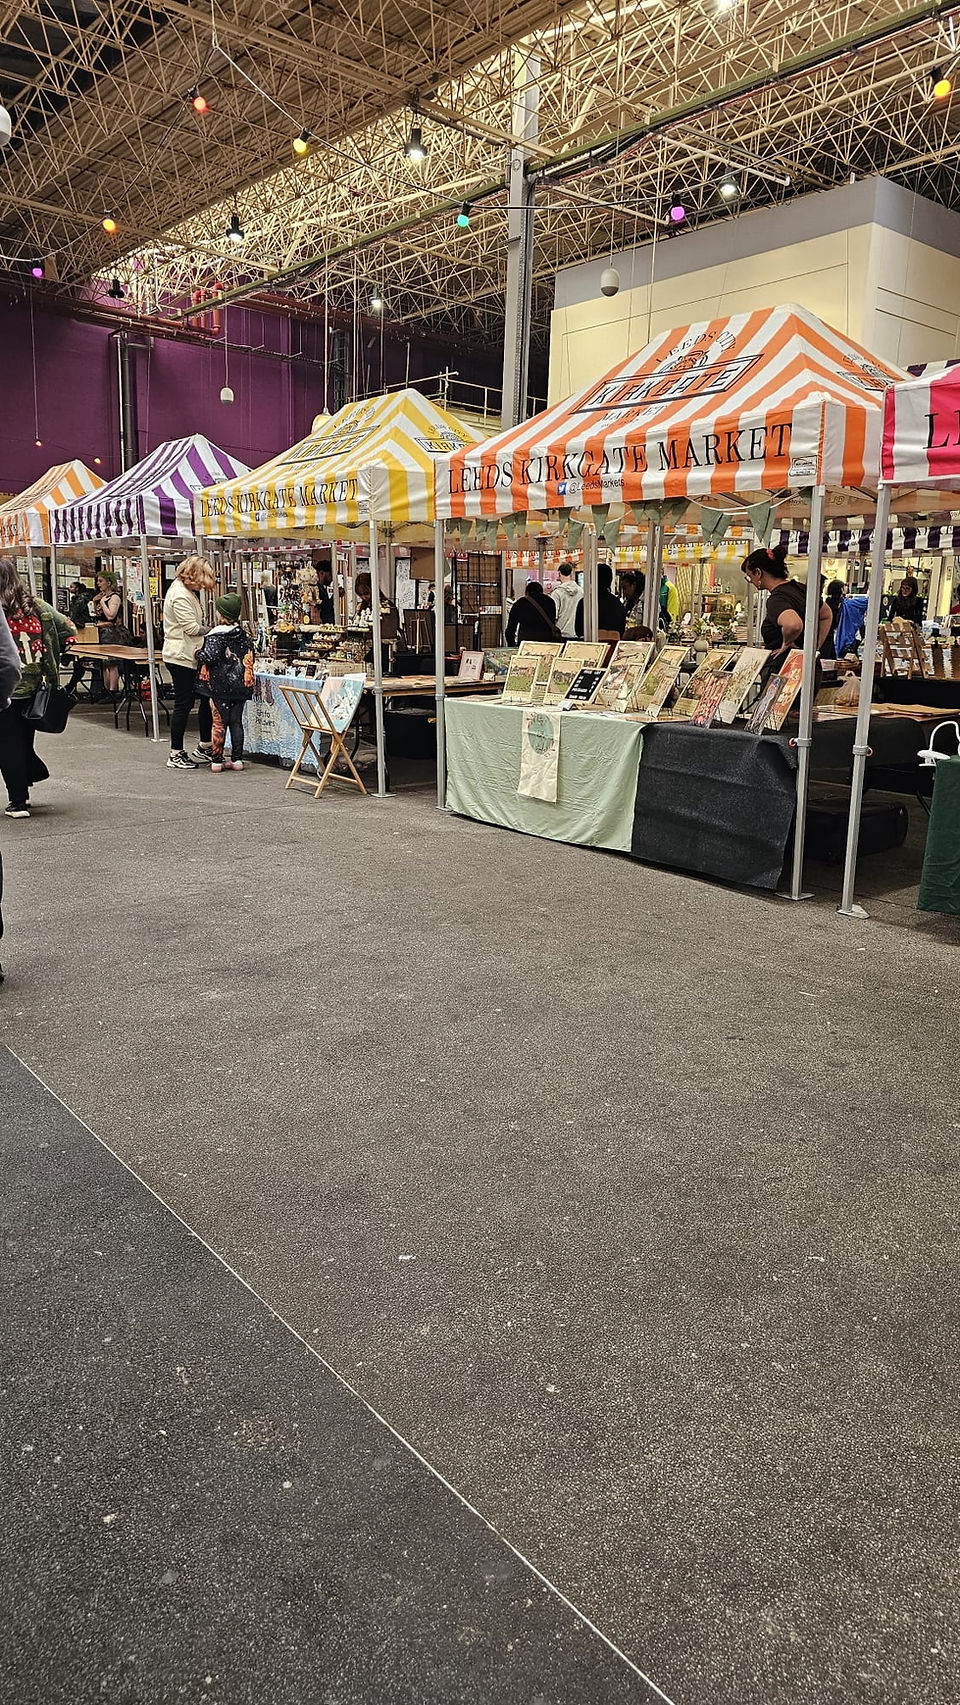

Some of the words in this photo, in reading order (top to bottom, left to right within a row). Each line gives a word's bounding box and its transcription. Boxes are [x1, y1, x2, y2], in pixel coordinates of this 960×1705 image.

[655, 331, 717, 363] LEEDS
[588, 365, 742, 406] KIRKGATE
[448, 462, 513, 494] LEEDS
[519, 445, 648, 485] KIRKGATE
[657, 423, 793, 471] MARKET
[200, 495, 234, 517] LEEDS
[236, 487, 296, 513] KIRKGATE
[299, 479, 357, 507] MARKET
[567, 477, 625, 494] @LeedsMarkets
